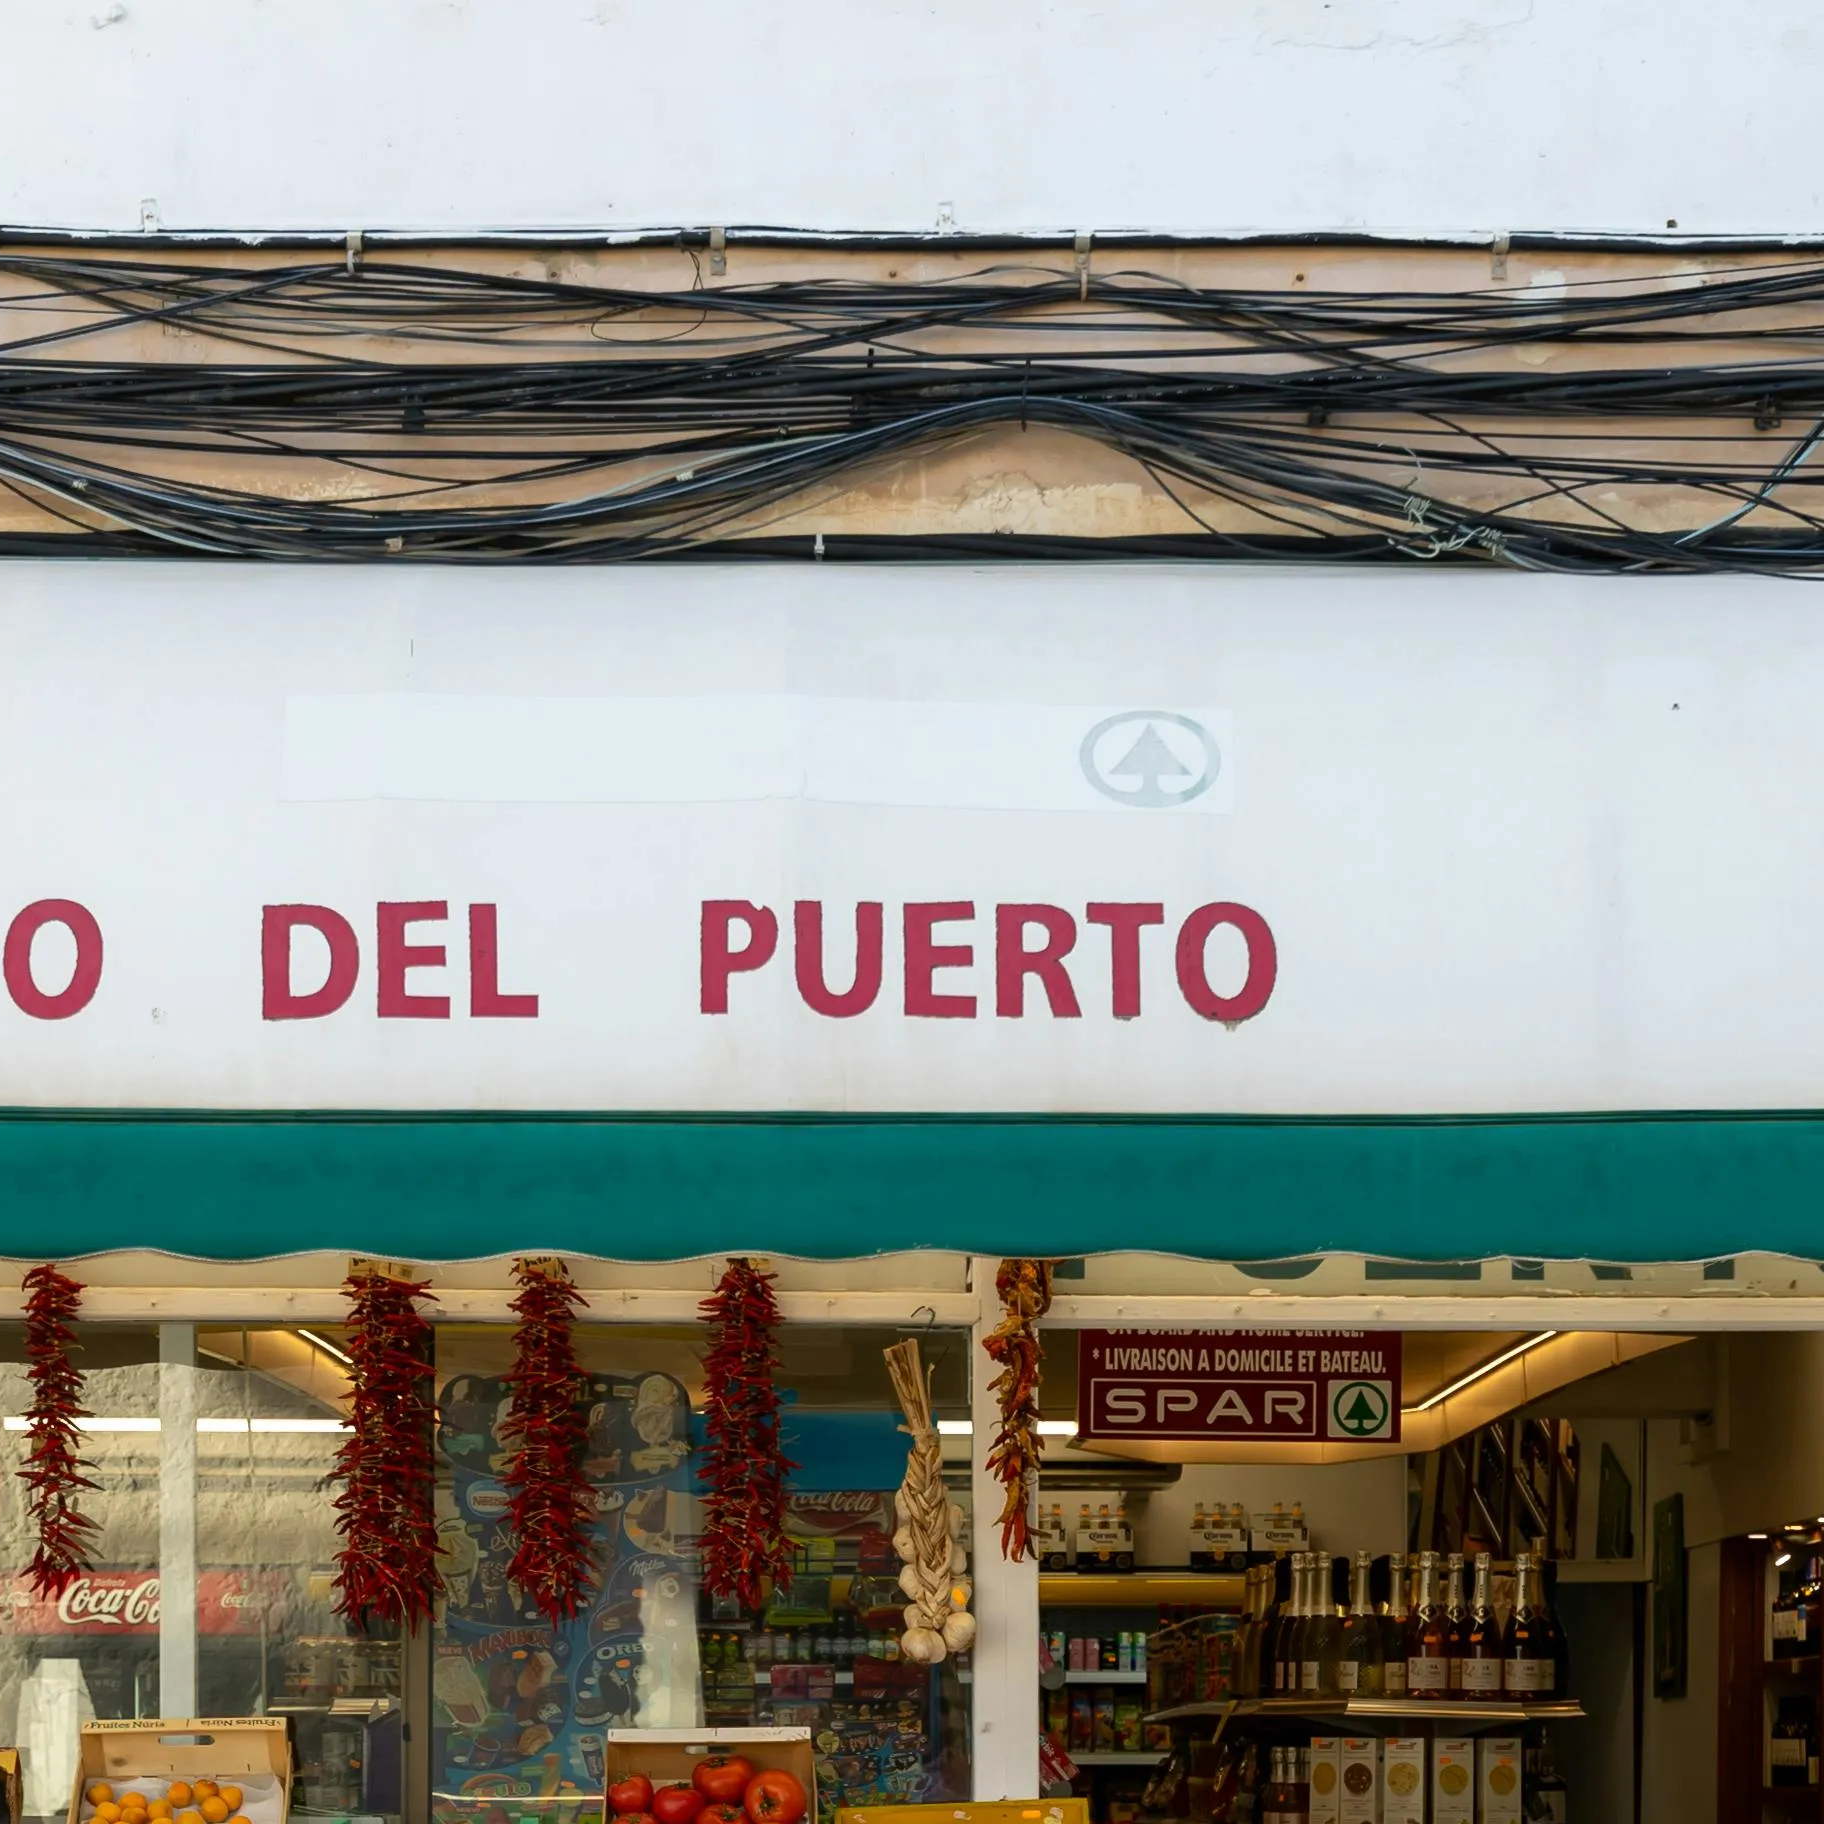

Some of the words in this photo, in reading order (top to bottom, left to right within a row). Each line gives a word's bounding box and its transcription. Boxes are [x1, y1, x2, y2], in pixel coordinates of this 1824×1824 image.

[261, 901, 539, 1021] DEL
[700, 901, 1277, 1022] PUERTO
[1105, 1348, 1193, 1371] LIVRAISON
[1197, 1349, 1210, 1371] A
[1215, 1349, 1293, 1372] DOMICILE
[1298, 1350, 1316, 1372] ET
[1321, 1350, 1386, 1373] BATEAU.
[1105, 1388, 1304, 1424] SPAR
